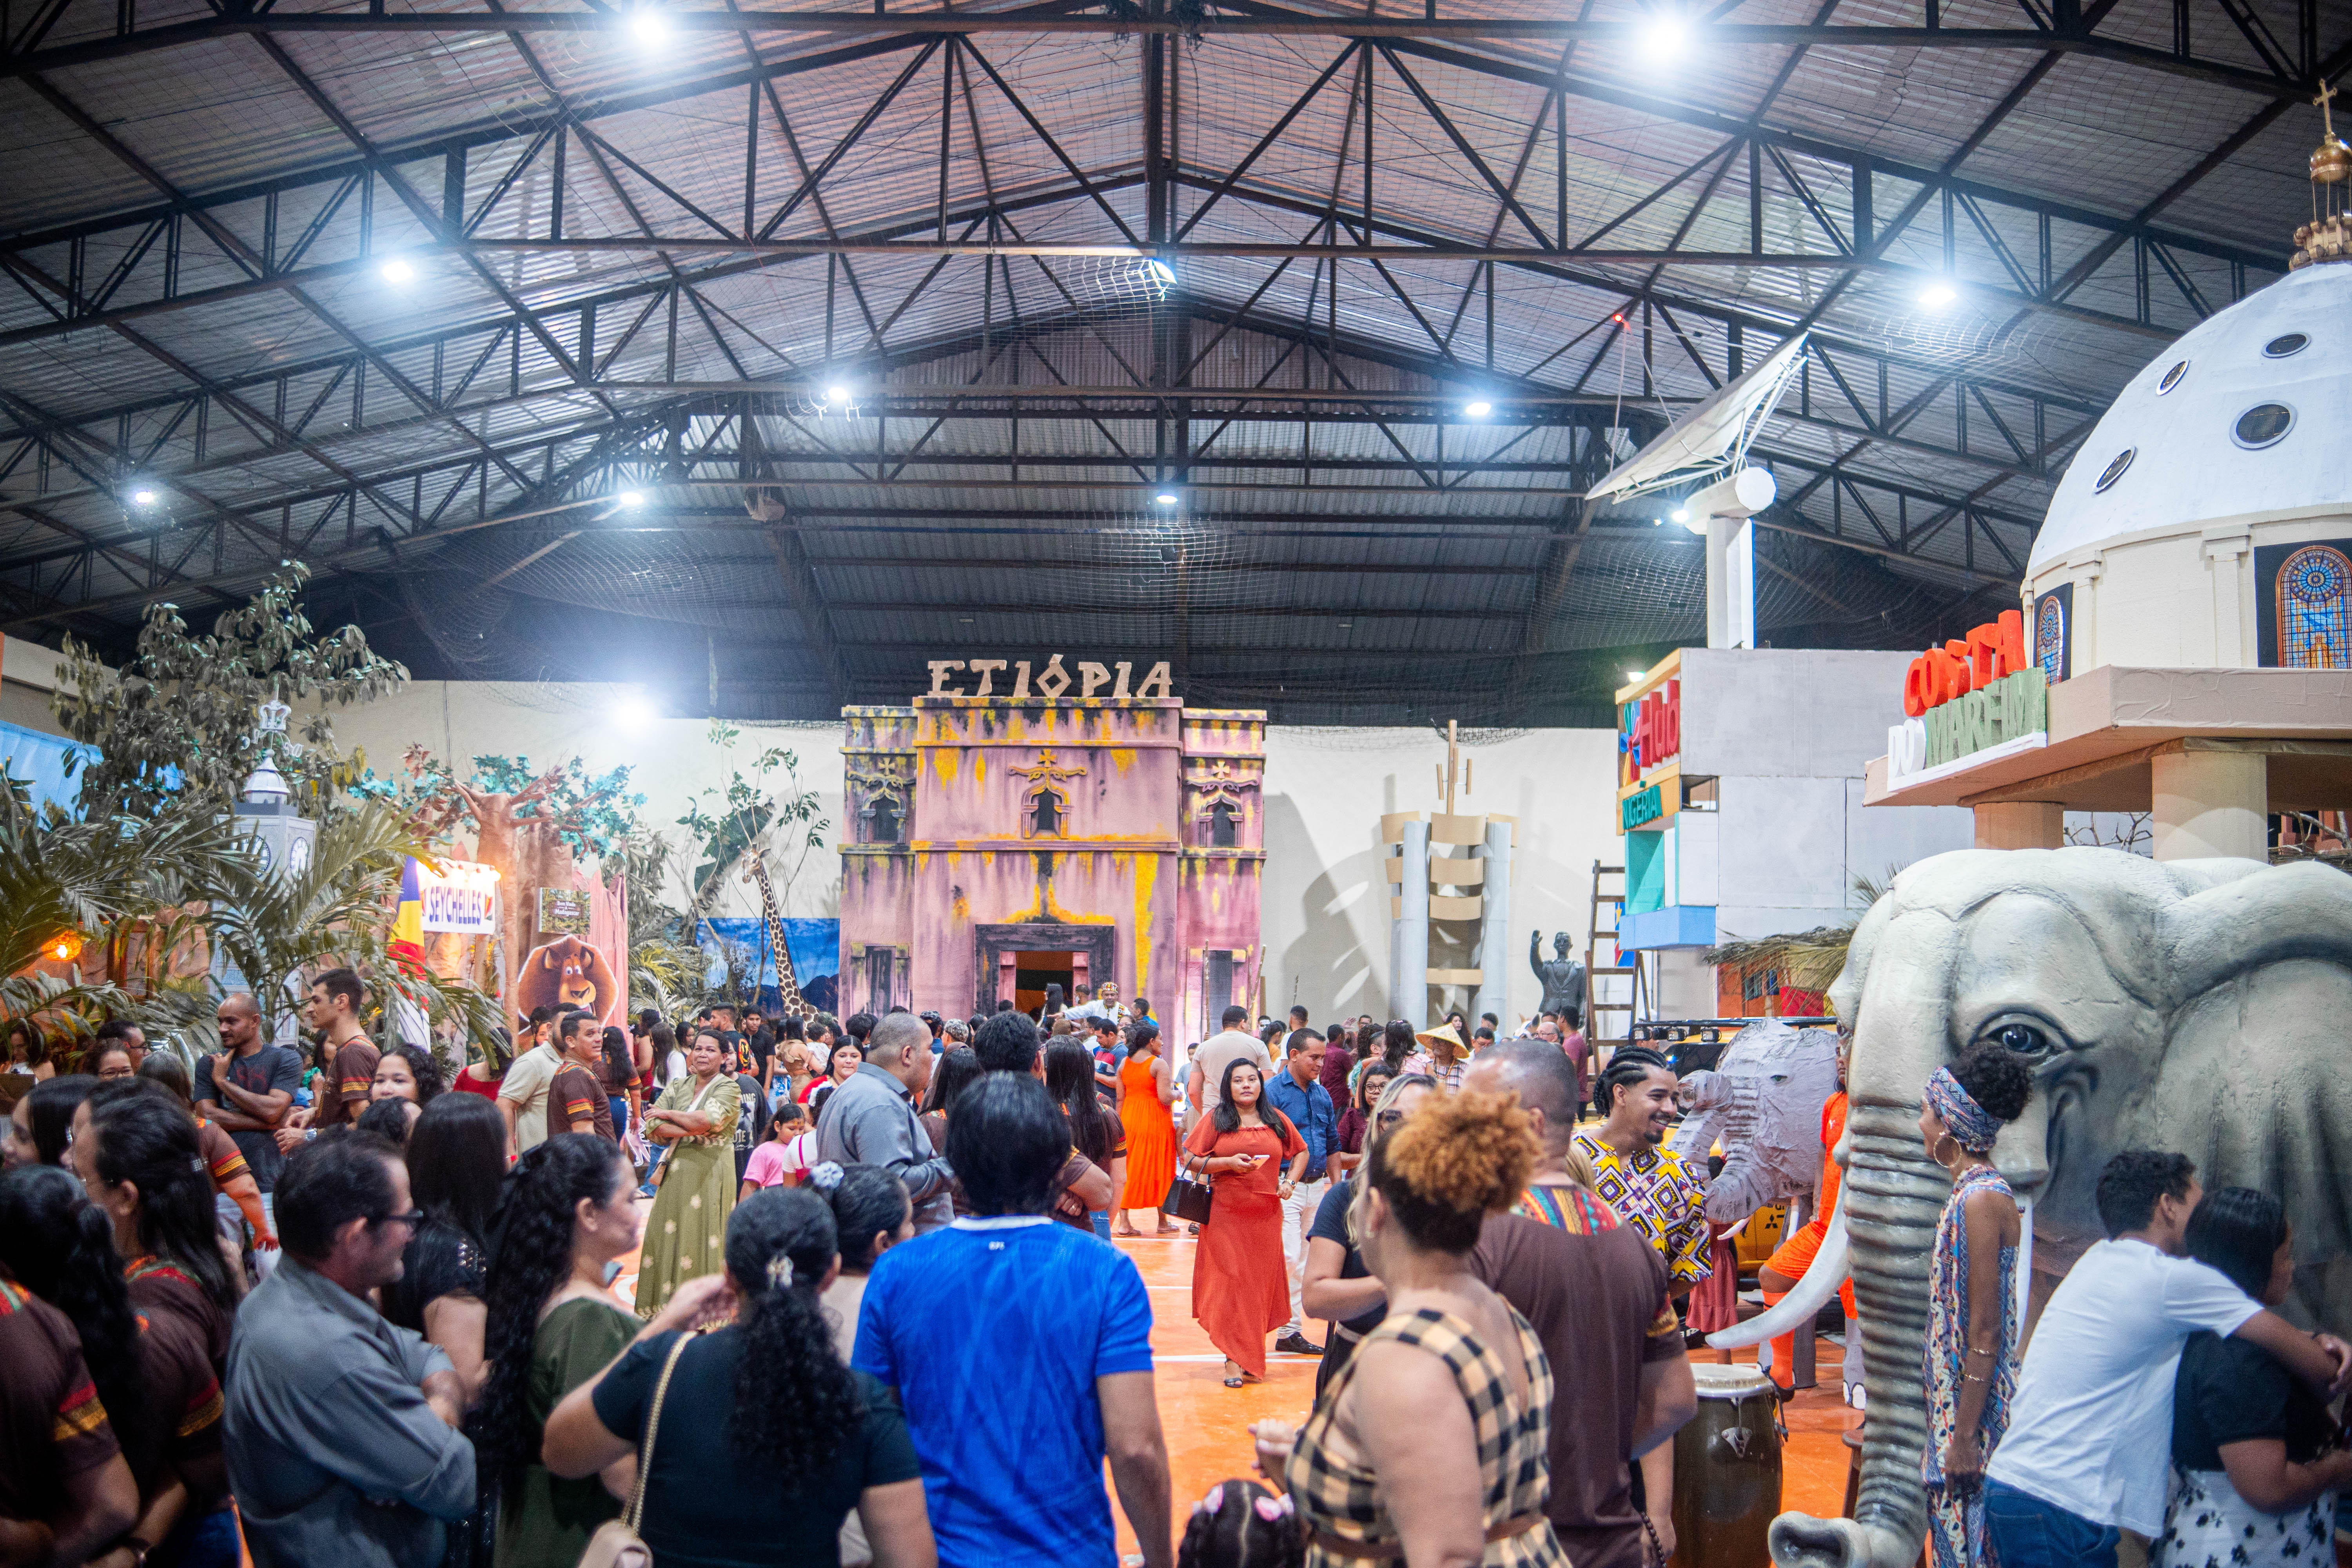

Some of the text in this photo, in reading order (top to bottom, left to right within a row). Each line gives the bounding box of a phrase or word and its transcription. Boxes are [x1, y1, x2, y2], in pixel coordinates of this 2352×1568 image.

[927, 655, 1172, 697] ETIÓPIA
[1904, 610, 2027, 717] COSTA
[1640, 680, 1680, 768] Hub
[1888, 667, 2045, 778] DO MARFIM
[429, 886, 481, 926] SEYCHELLES
[555, 908, 580, 916] Madagascar
